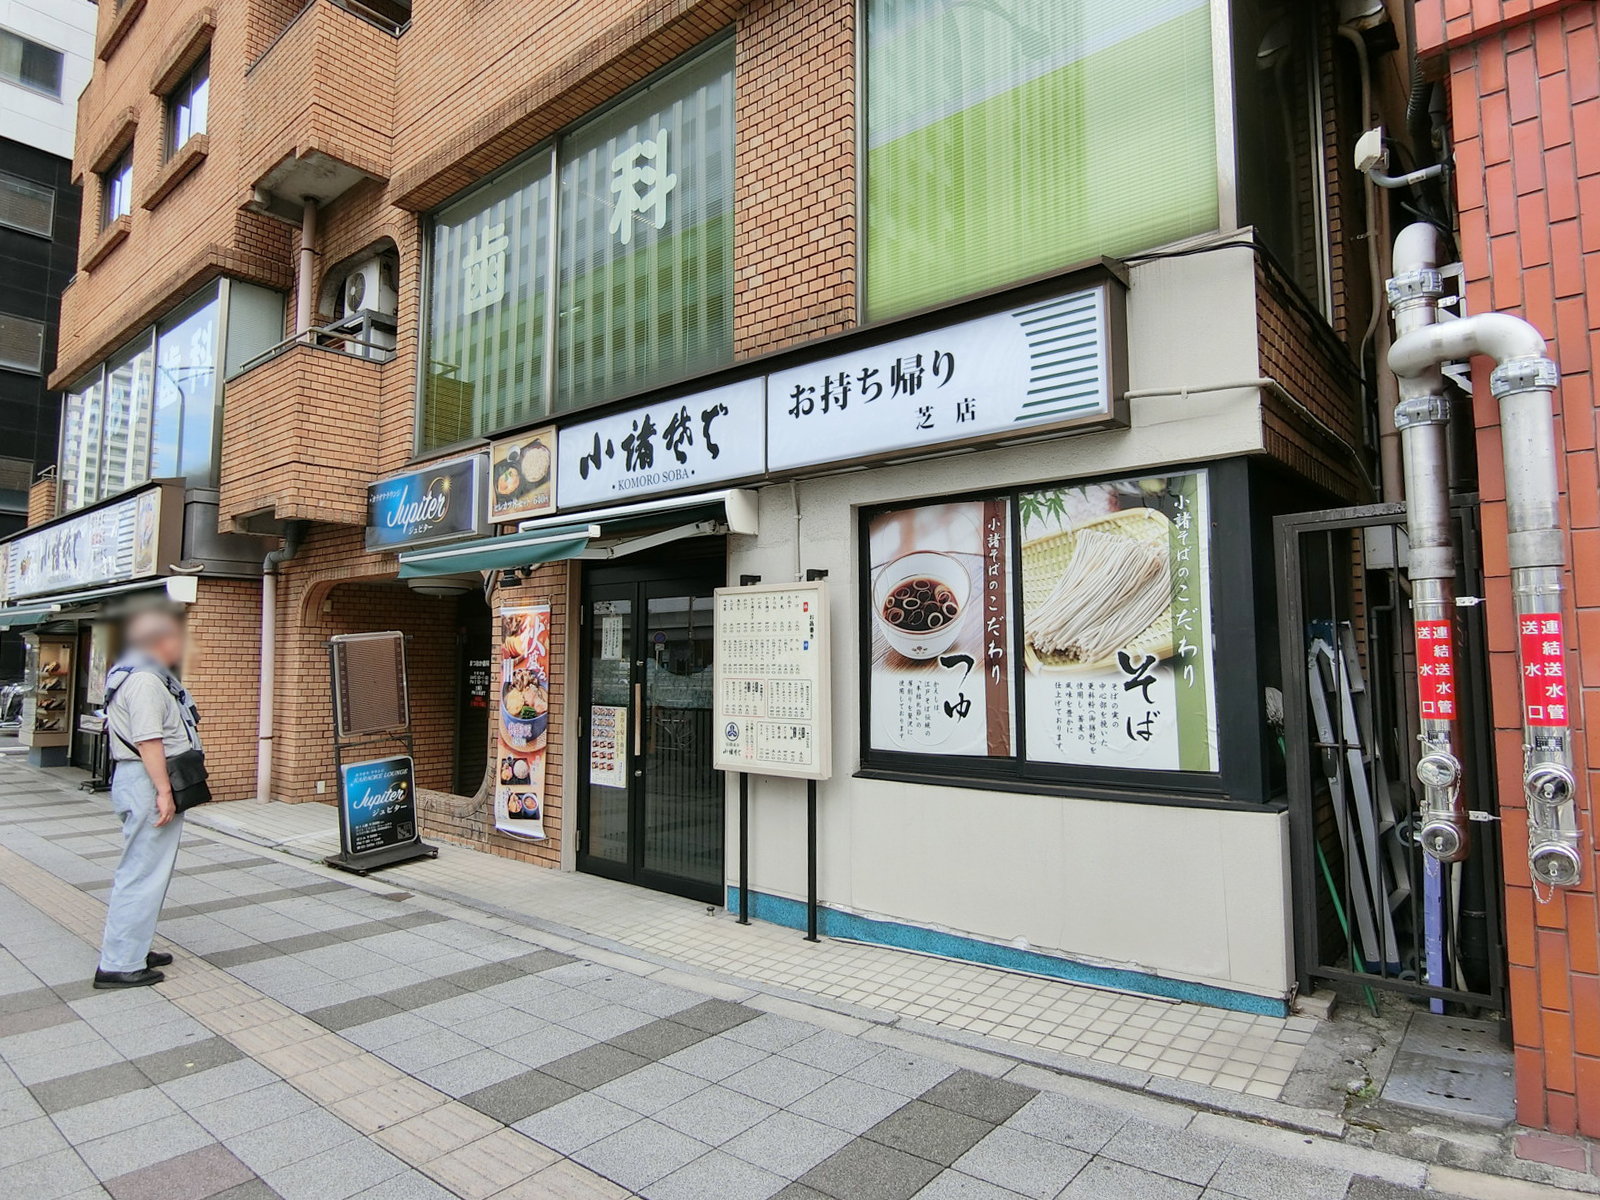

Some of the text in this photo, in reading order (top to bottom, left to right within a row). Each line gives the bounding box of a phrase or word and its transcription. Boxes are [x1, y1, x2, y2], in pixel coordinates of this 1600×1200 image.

[788, 349, 955, 419] お持ち帰り
[387, 484, 446, 534] Jupiter
[618, 468, 689, 491] KOMORO SOBA
[986, 518, 1004, 686] 小諸そばのこだわり
[1174, 494, 1198, 689] 小諸そばのこだわり
[939, 653, 975, 723] つゆ
[1117, 651, 1161, 742] そば
[1417, 627, 1435, 713] 送水口
[1432, 626, 1453, 714] 連結送水管
[1521, 621, 1544, 719] 送水口
[1541, 620, 1564, 720] 連結送水管
[1065, 682, 1073, 734] 風味を豊かに
[1099, 682, 1108, 747] 中心部を挽いた
[1110, 683, 1119, 728] そばの実の
[353, 787, 404, 810] Jupiter
[354, 768, 408, 784] KARAOKE LOUNGE
